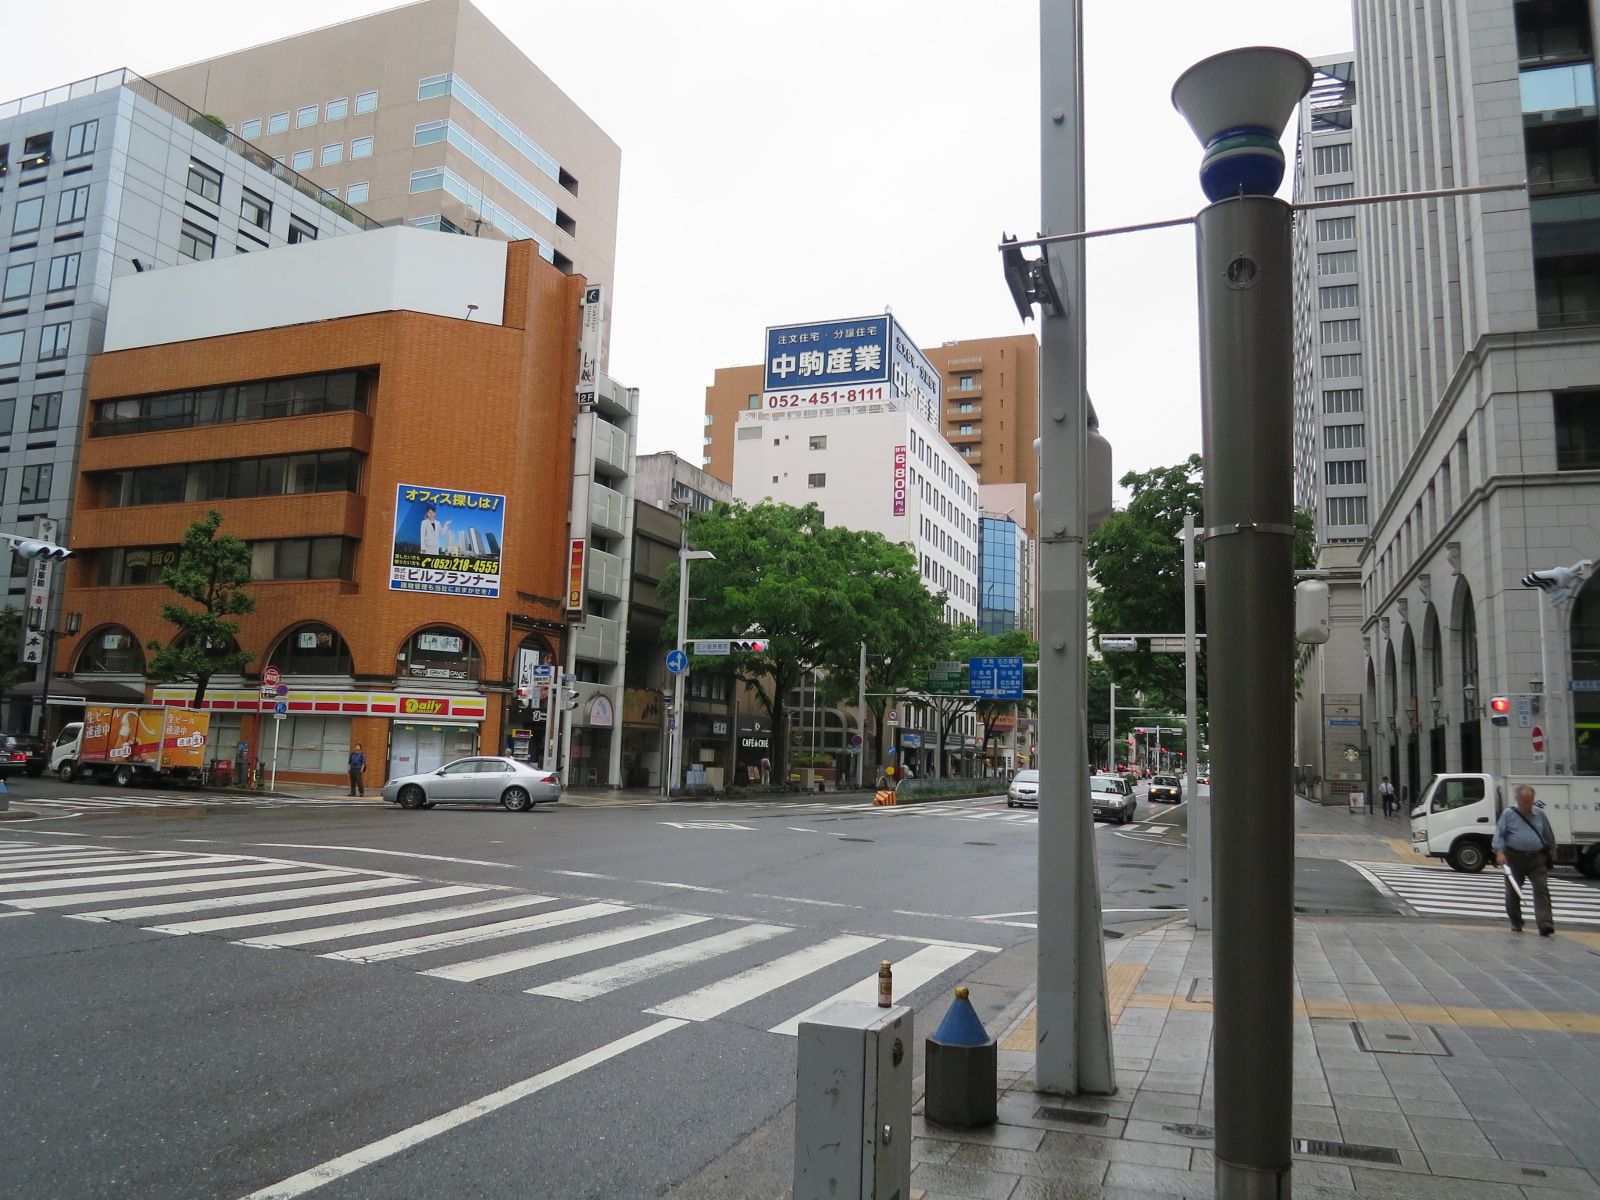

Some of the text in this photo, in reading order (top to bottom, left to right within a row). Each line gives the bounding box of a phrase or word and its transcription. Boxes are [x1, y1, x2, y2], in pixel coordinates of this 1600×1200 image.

[771, 345, 882, 379] 中駒産業
[581, 393, 593, 402] 2F
[769, 387, 883, 408] 052-451-8111
[408, 569, 498, 586] ビルプランナー
[405, 698, 443, 714] Daily
